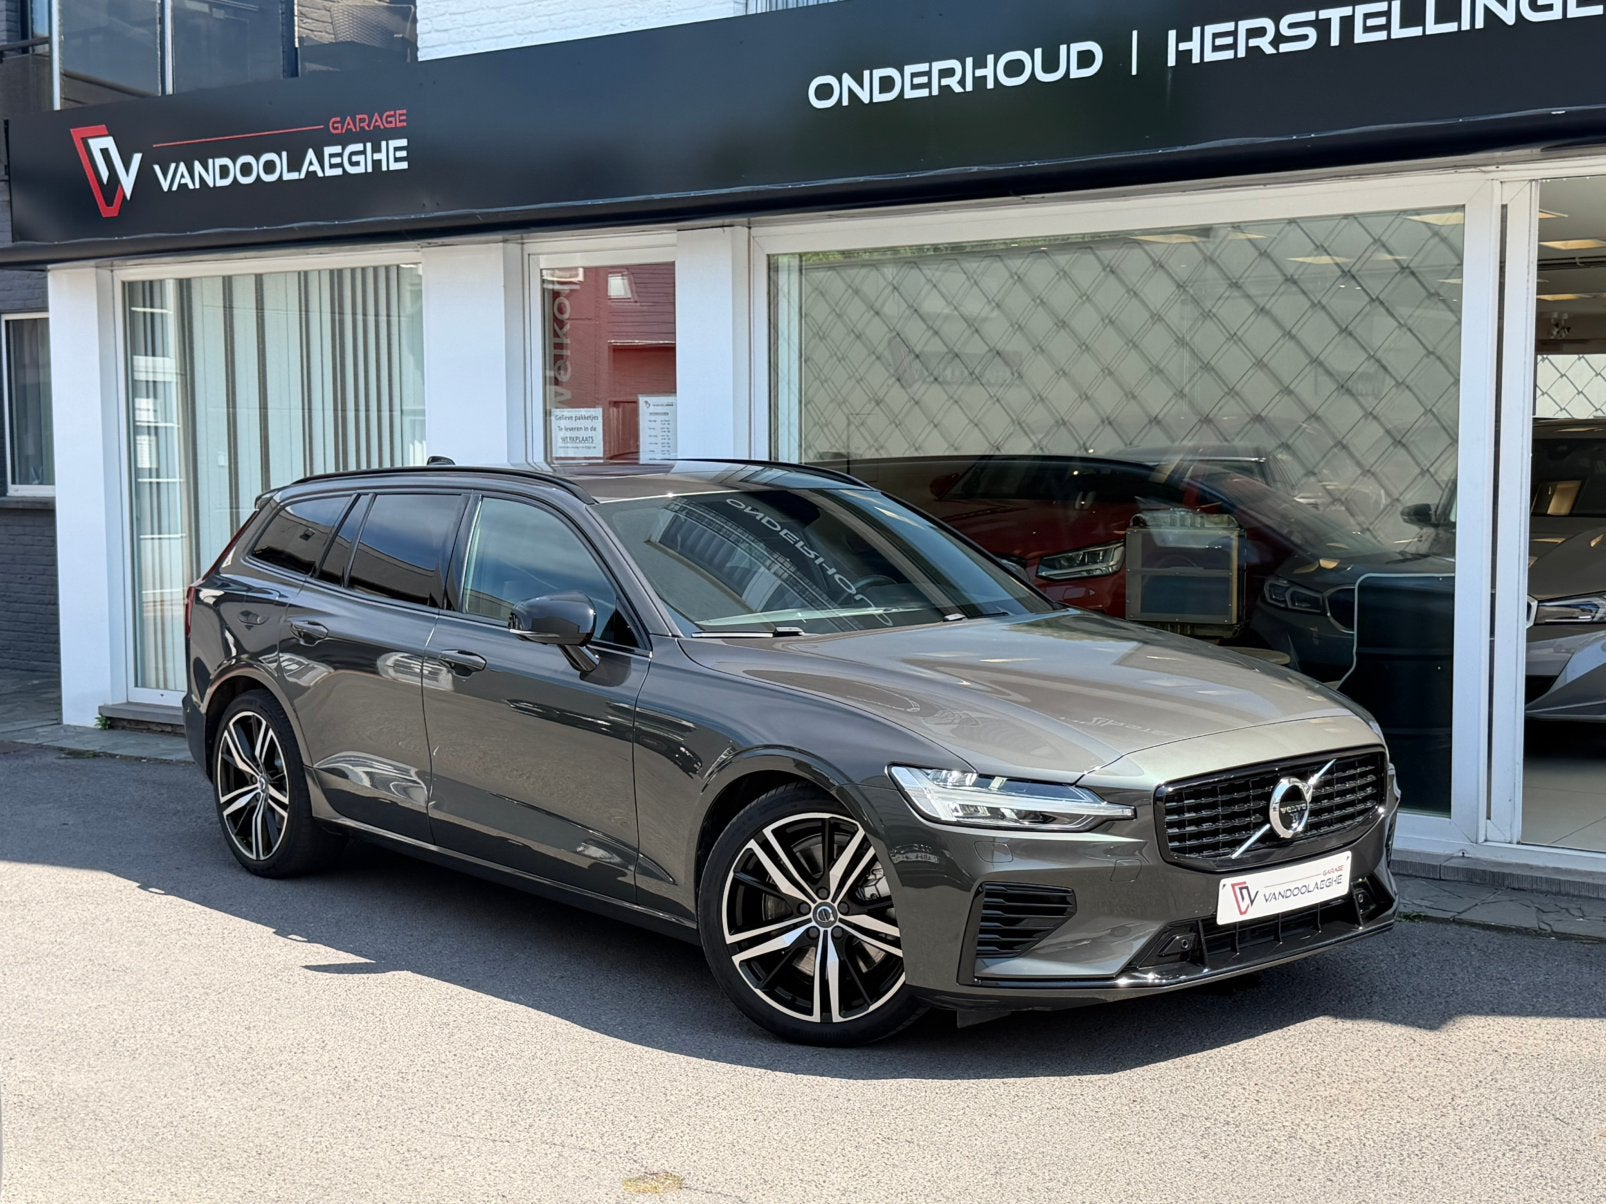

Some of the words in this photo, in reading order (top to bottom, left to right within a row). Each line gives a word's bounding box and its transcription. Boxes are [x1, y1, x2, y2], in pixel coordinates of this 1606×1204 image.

[807, 40, 1103, 109] ONDERHOUD
[328, 109, 408, 135] GARAGE
[152, 138, 409, 193] VANDOOLAEGHE
[1263, 874, 1343, 903] VANDOOLAEGHE
